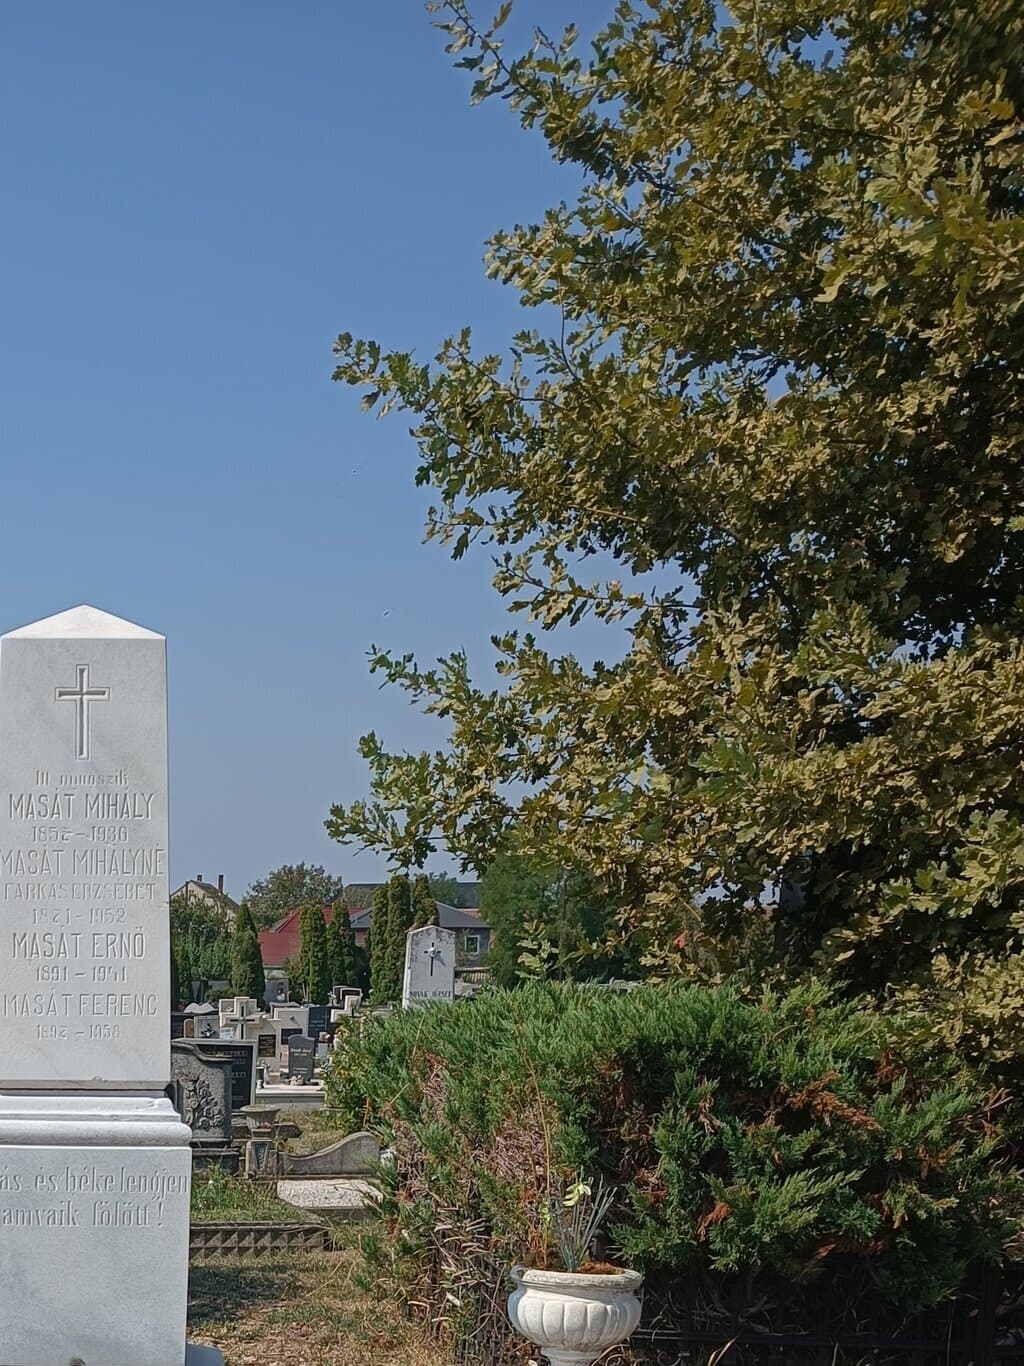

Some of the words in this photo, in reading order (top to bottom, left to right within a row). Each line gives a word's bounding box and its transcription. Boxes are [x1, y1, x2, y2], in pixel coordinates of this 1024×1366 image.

[9, 787, 76, 820] MASÁT
[85, 787, 157, 820] MIHÁLY
[73, 842, 166, 877] MIHÁLYNÉ
[12, 926, 82, 959] MASÁT
[3, 988, 73, 1017] MASÁT
[78, 993, 160, 1017] FERENC
[34, 1166, 59, 1192] és
[65, 1166, 116, 1192] béke
